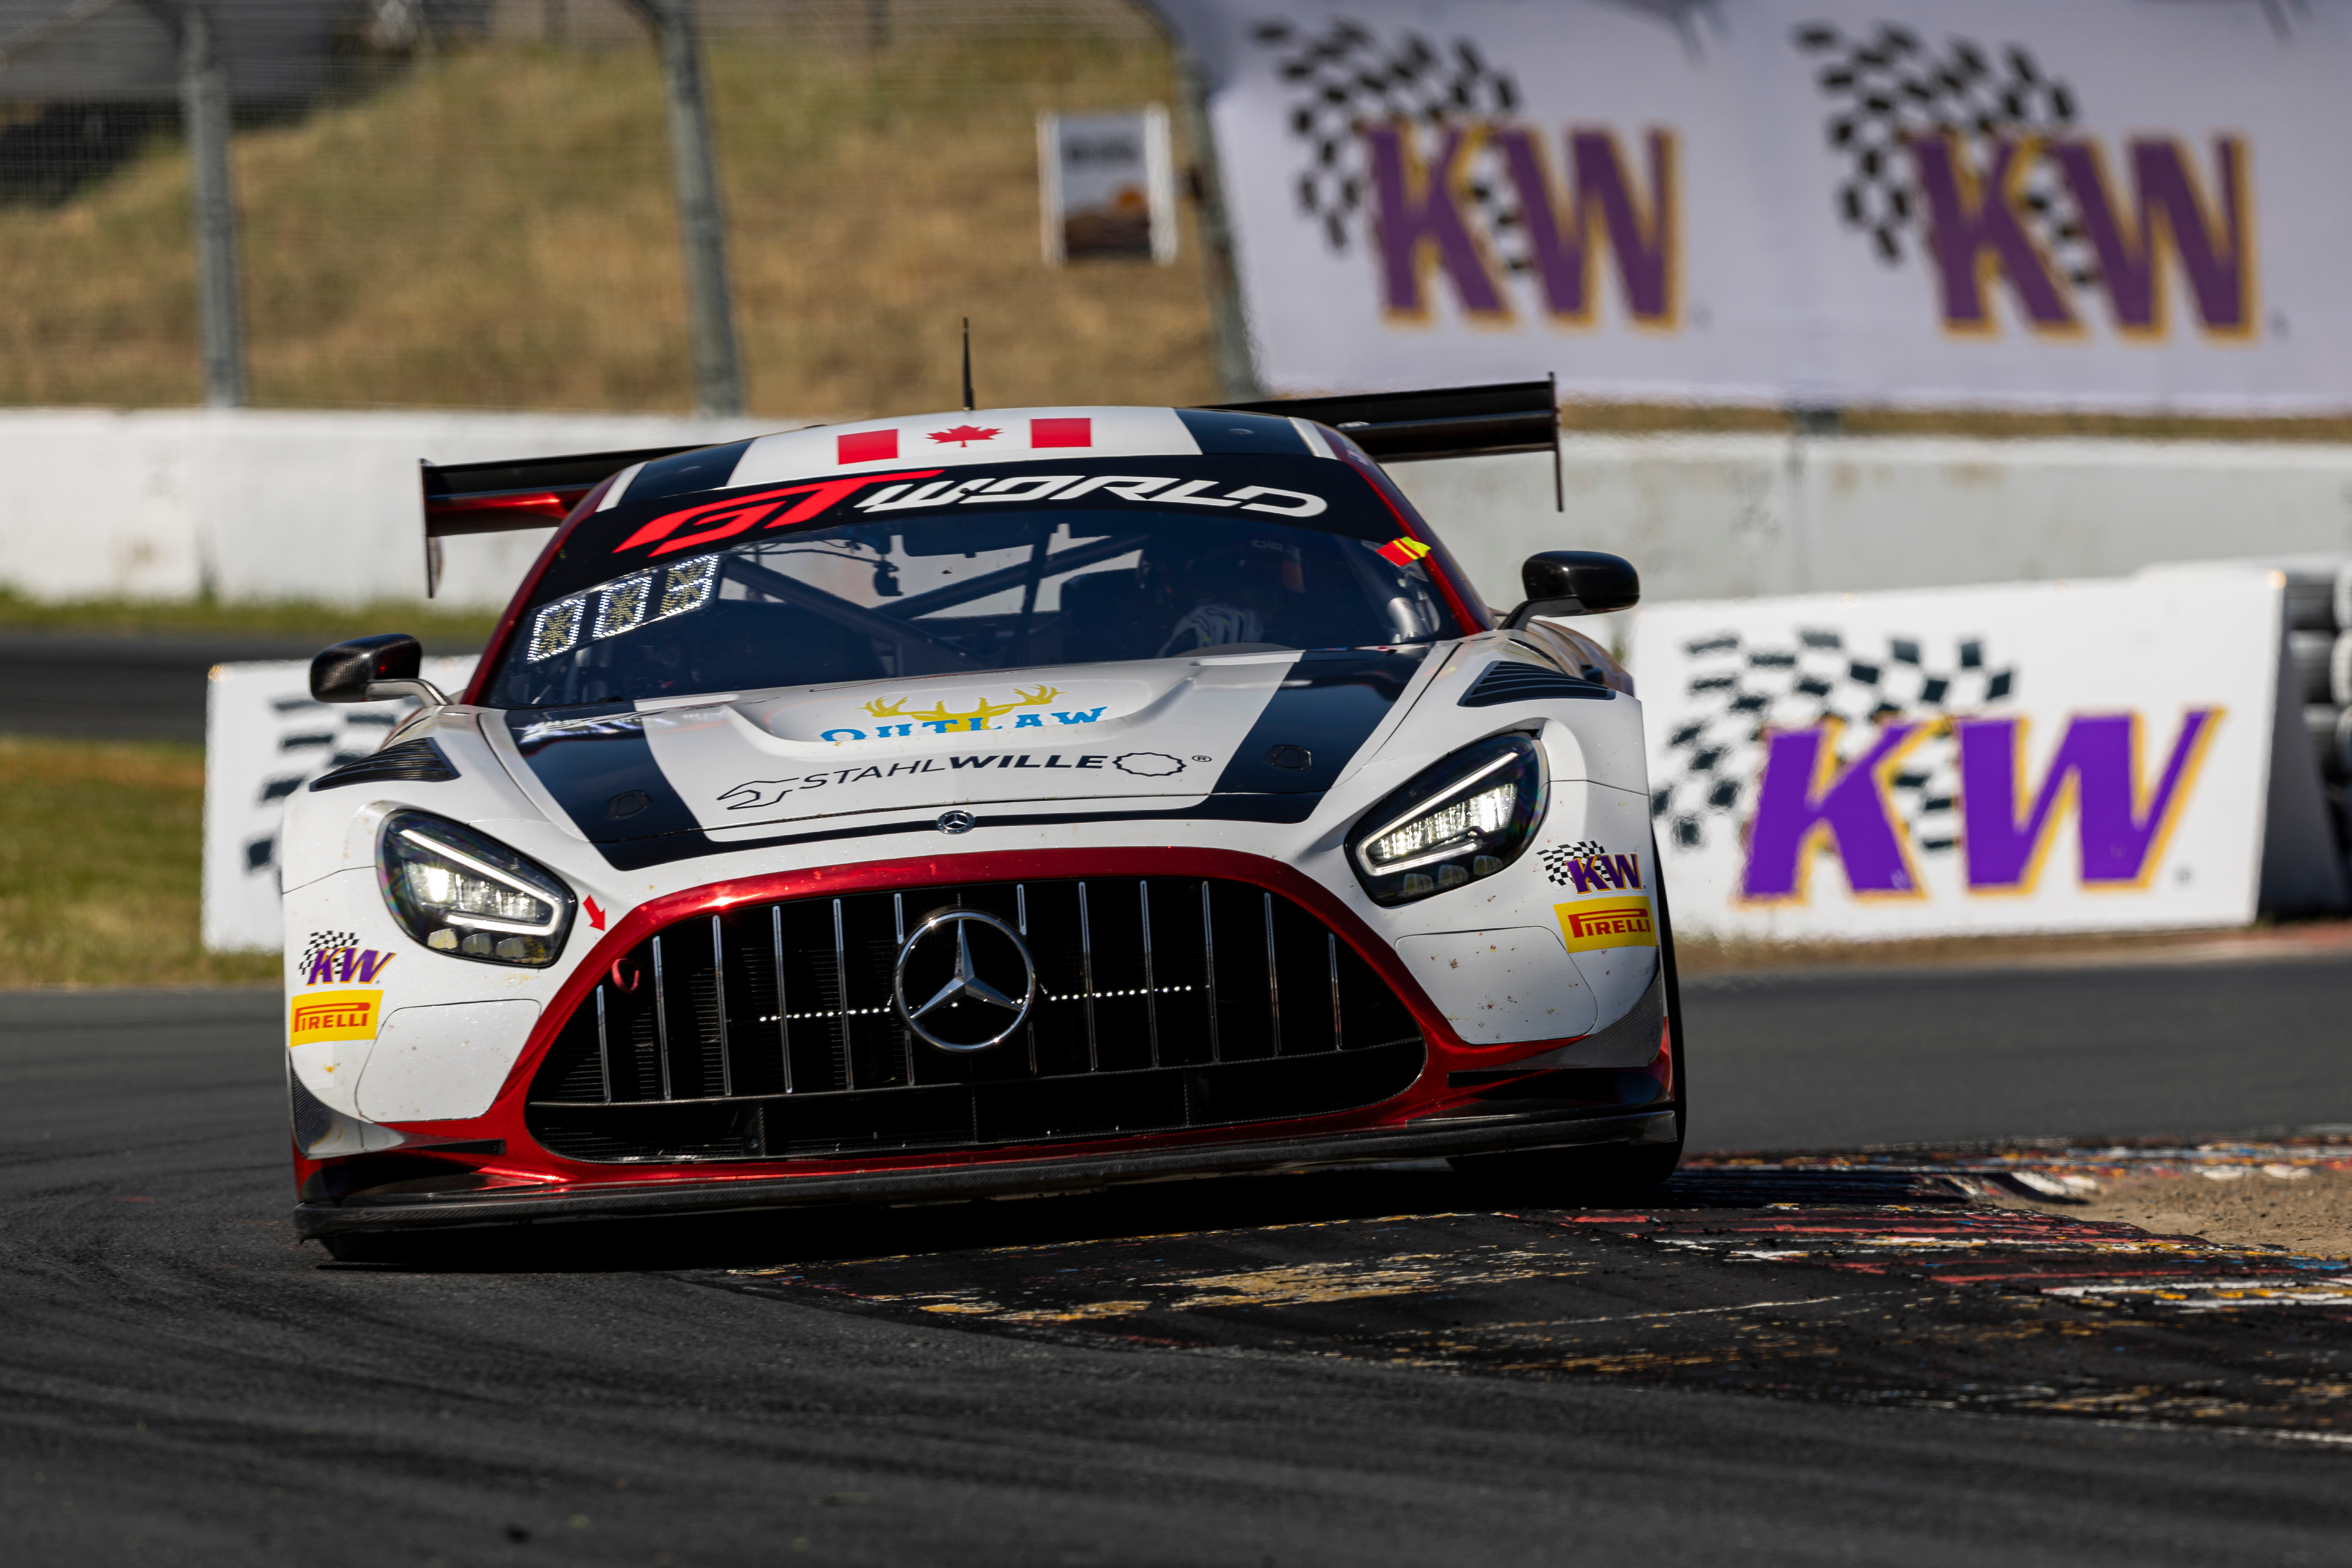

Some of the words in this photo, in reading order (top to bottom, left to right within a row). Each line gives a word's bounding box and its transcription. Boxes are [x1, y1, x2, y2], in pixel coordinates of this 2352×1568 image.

[1363, 120, 1681, 330] KW
[1905, 132, 2259, 340] KW
[799, 755, 1109, 789] STAHLWILLE
[1729, 706, 2227, 906] KW
[1564, 853, 1642, 895] KW
[1568, 908, 1651, 938] PIRELLI
[306, 946, 397, 986] KW
[294, 1002, 371, 1032] PIRELLI
